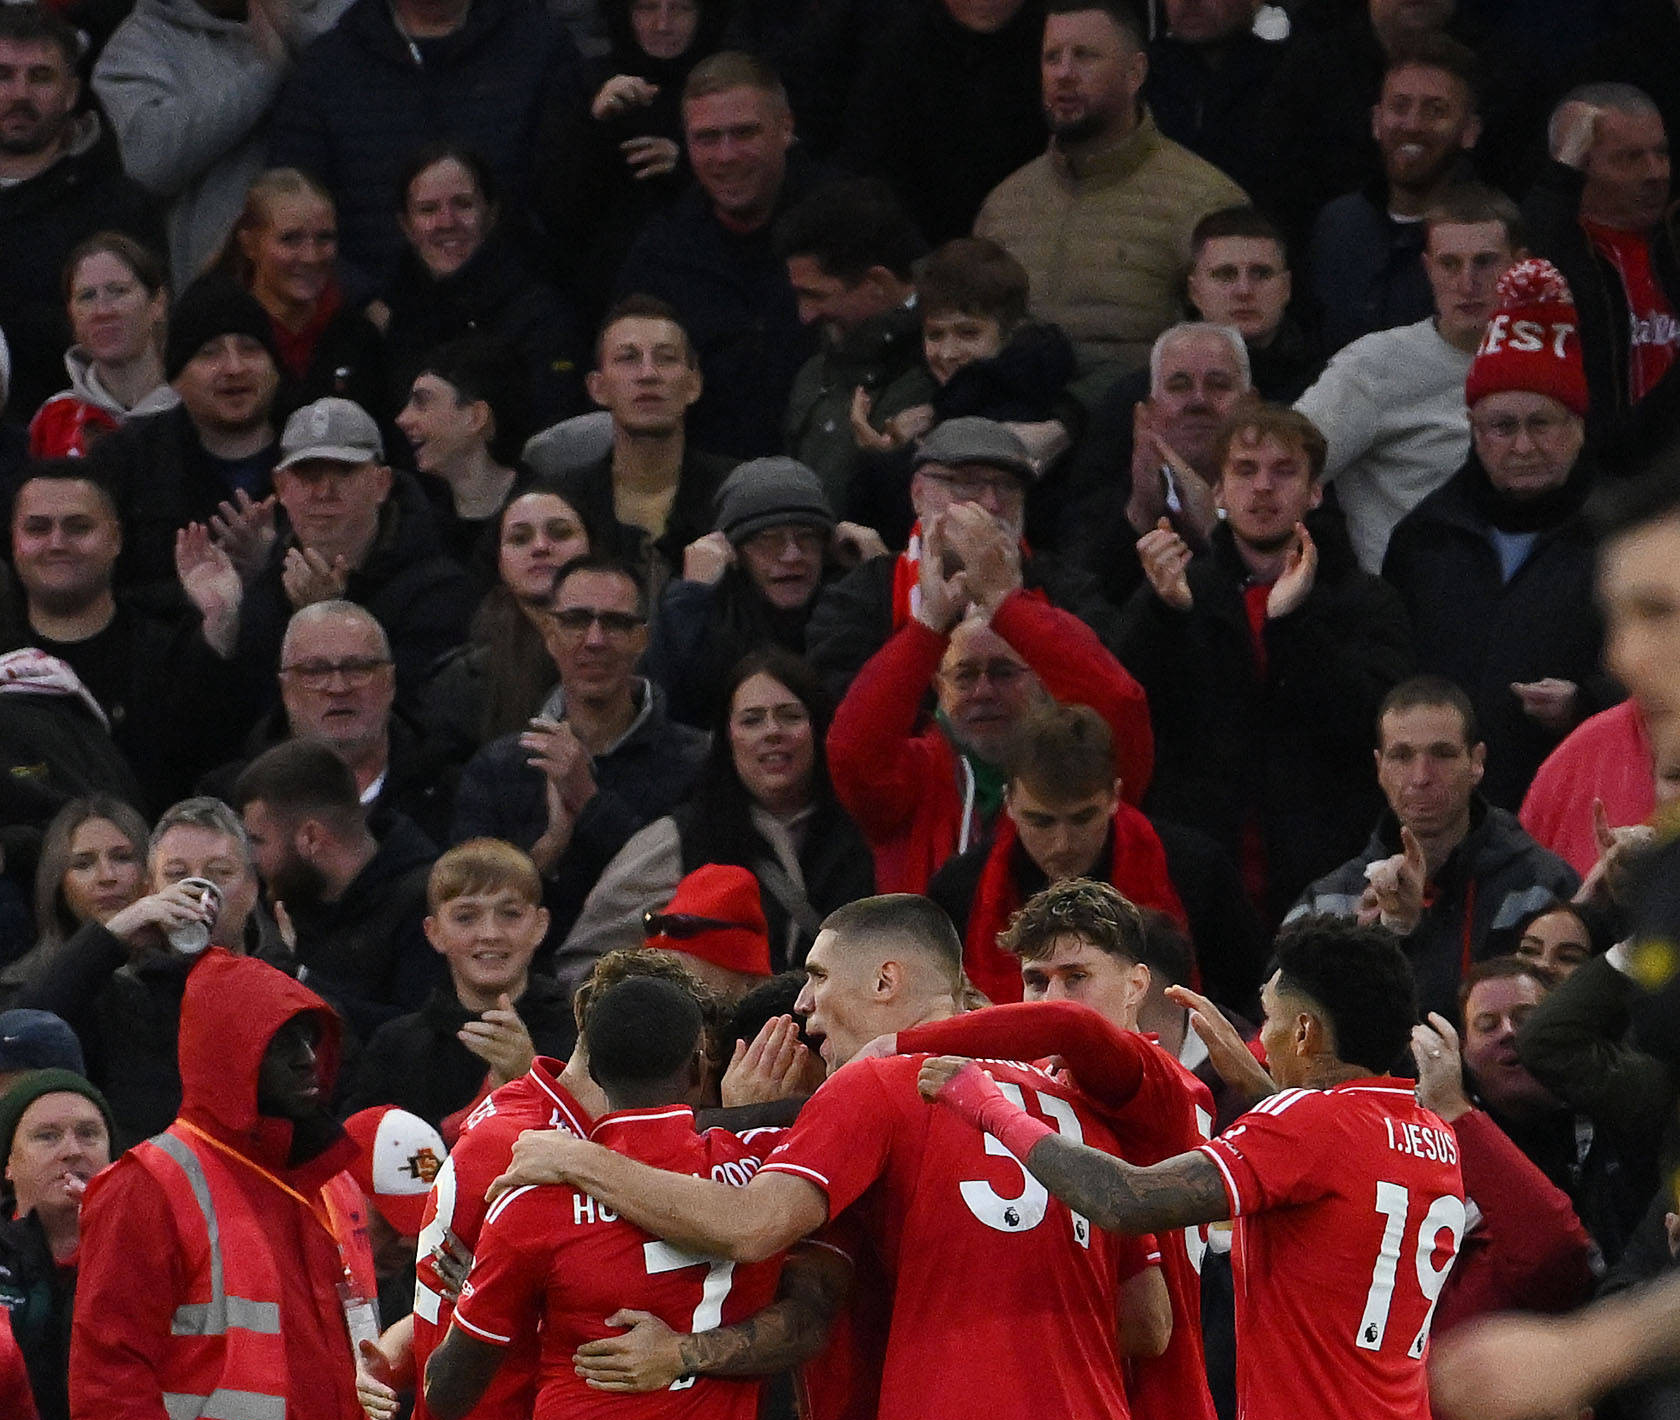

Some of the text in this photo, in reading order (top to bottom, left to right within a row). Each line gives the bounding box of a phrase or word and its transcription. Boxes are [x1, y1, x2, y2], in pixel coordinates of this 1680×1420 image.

[1384, 1117, 1458, 1166] I.JESUS
[643, 1238, 736, 1391] 7
[1355, 1180, 1467, 1360] 19
